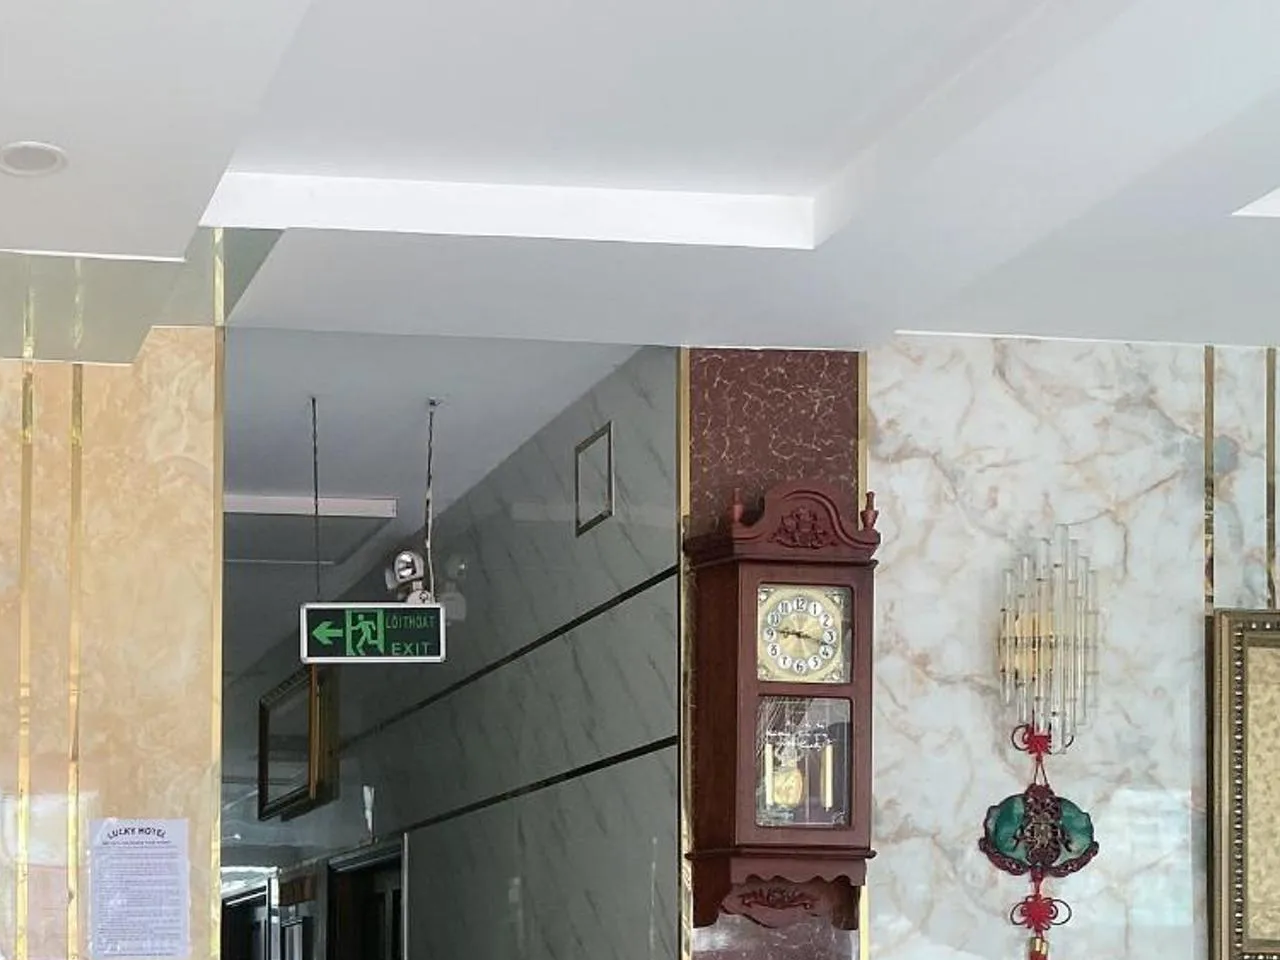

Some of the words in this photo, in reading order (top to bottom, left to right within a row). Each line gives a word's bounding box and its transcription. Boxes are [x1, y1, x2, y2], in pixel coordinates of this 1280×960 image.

[391, 641, 431, 656] EXIT
[107, 827, 136, 840] LUCKY
[138, 827, 167, 839] HOTEL
